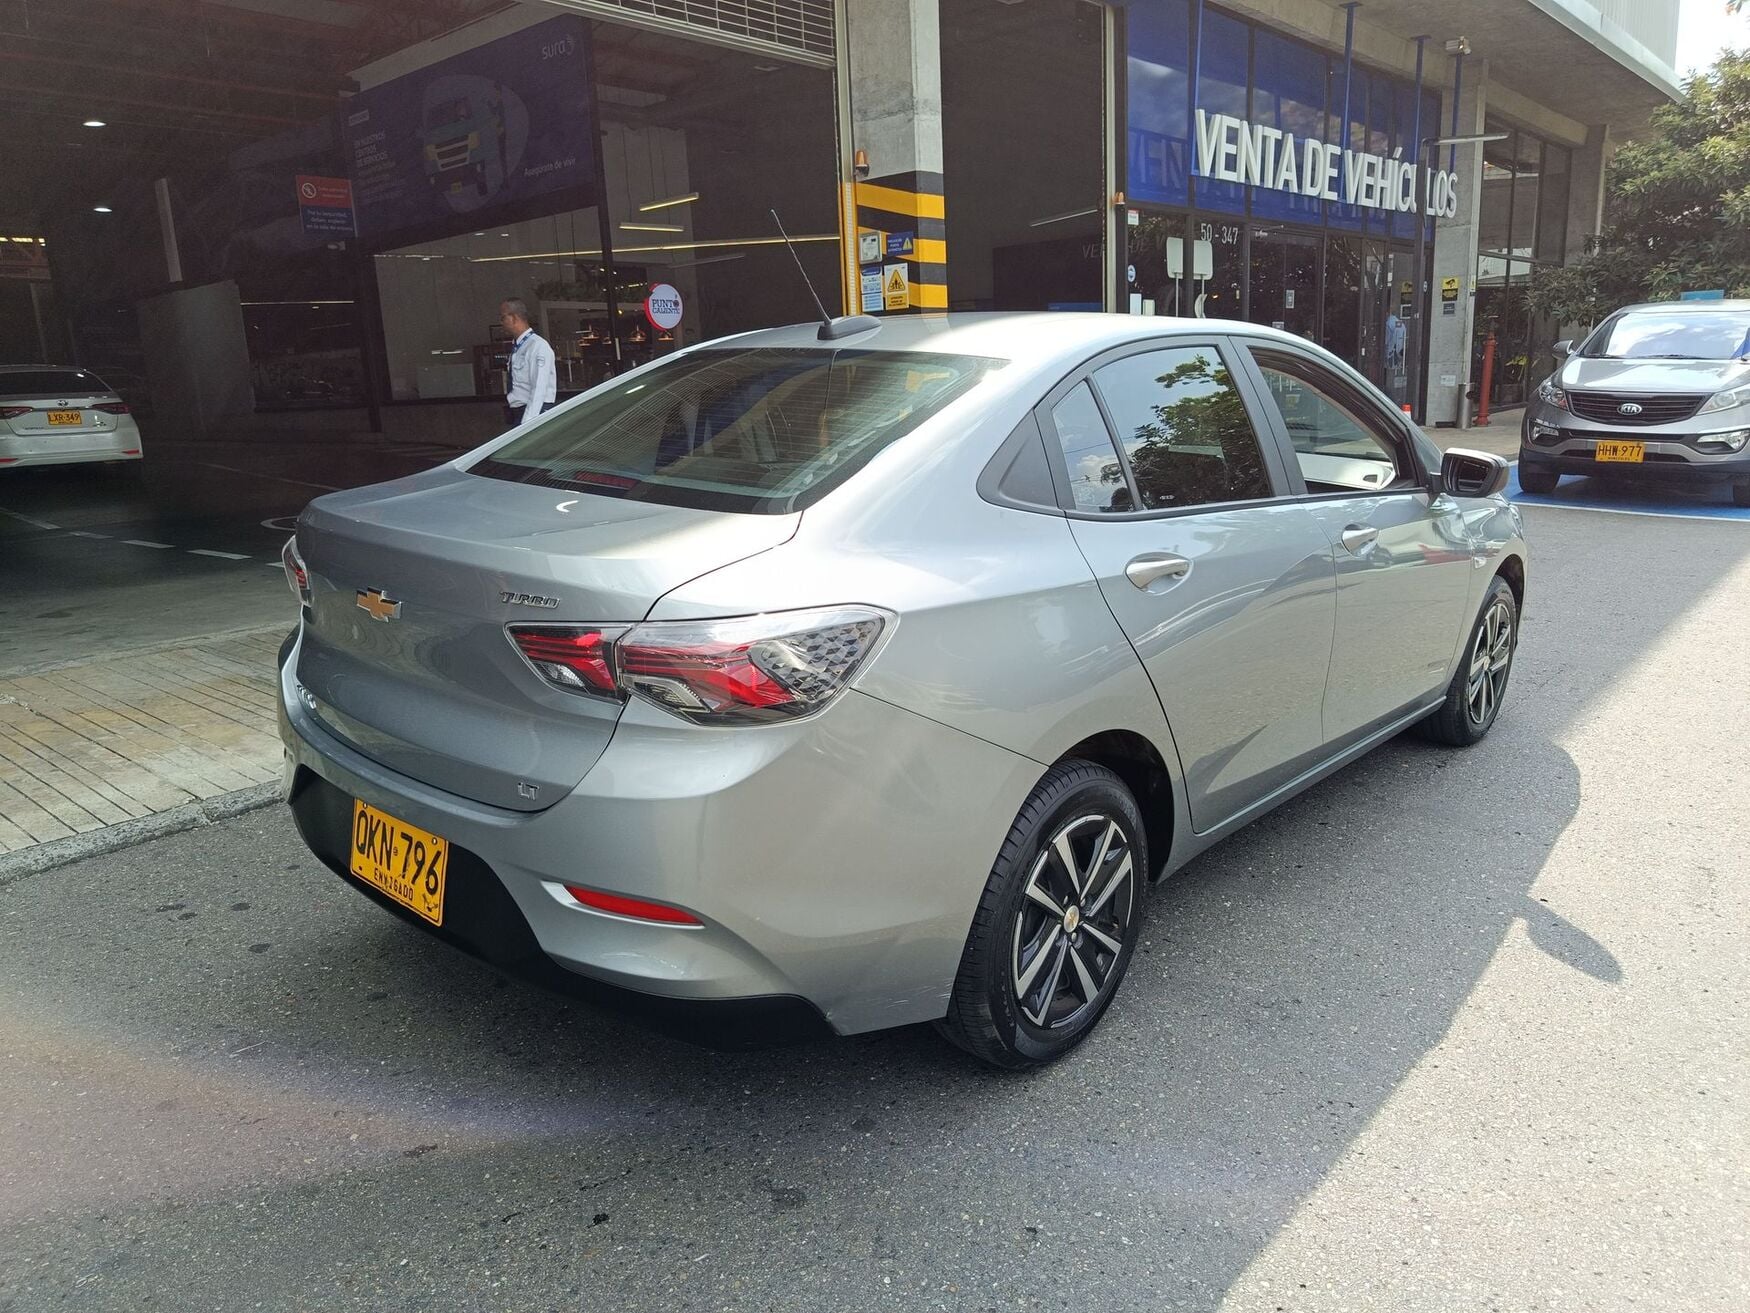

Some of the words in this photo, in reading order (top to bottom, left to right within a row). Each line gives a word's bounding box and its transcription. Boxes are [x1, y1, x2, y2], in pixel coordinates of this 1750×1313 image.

[542, 40, 566, 60] sura
[1195, 109, 1299, 194] VENTA
[1301, 138, 1342, 201] DE
[1201, 223, 1213, 242] 50
[1222, 226, 1239, 245] 347
[500, 591, 561, 610] TURBO
[517, 782, 540, 801] LT
